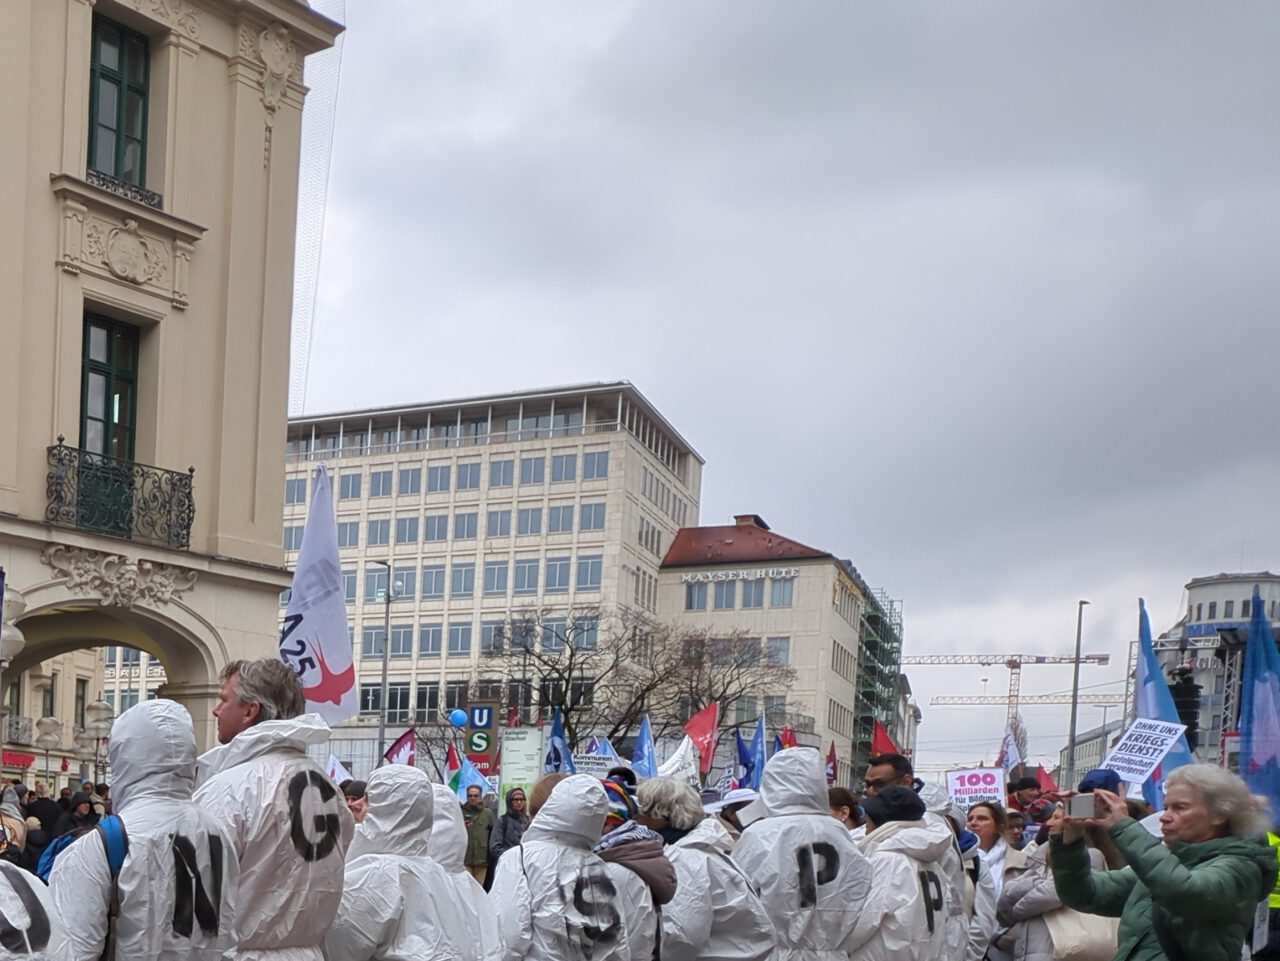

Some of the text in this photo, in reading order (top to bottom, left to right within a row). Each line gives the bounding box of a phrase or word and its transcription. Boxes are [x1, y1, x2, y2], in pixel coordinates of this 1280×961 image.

[681, 570, 748, 582] MAYSER
[473, 708, 488, 727] U
[1134, 722, 1180, 736] OHNE UNS
[471, 732, 488, 752] S
[1125, 732, 1169, 747] KRIEGS-
[473, 761, 490, 770] ram
[1109, 754, 1154, 769] Gefolgschaft
[955, 773, 996, 787] 100
[954, 787, 999, 796] Milliarden
[955, 796, 967, 804] für
[288, 769, 341, 862] G
[795, 842, 840, 908] P
[169, 831, 223, 939] N
[573, 875, 621, 942] S
[919, 870, 943, 936] P
